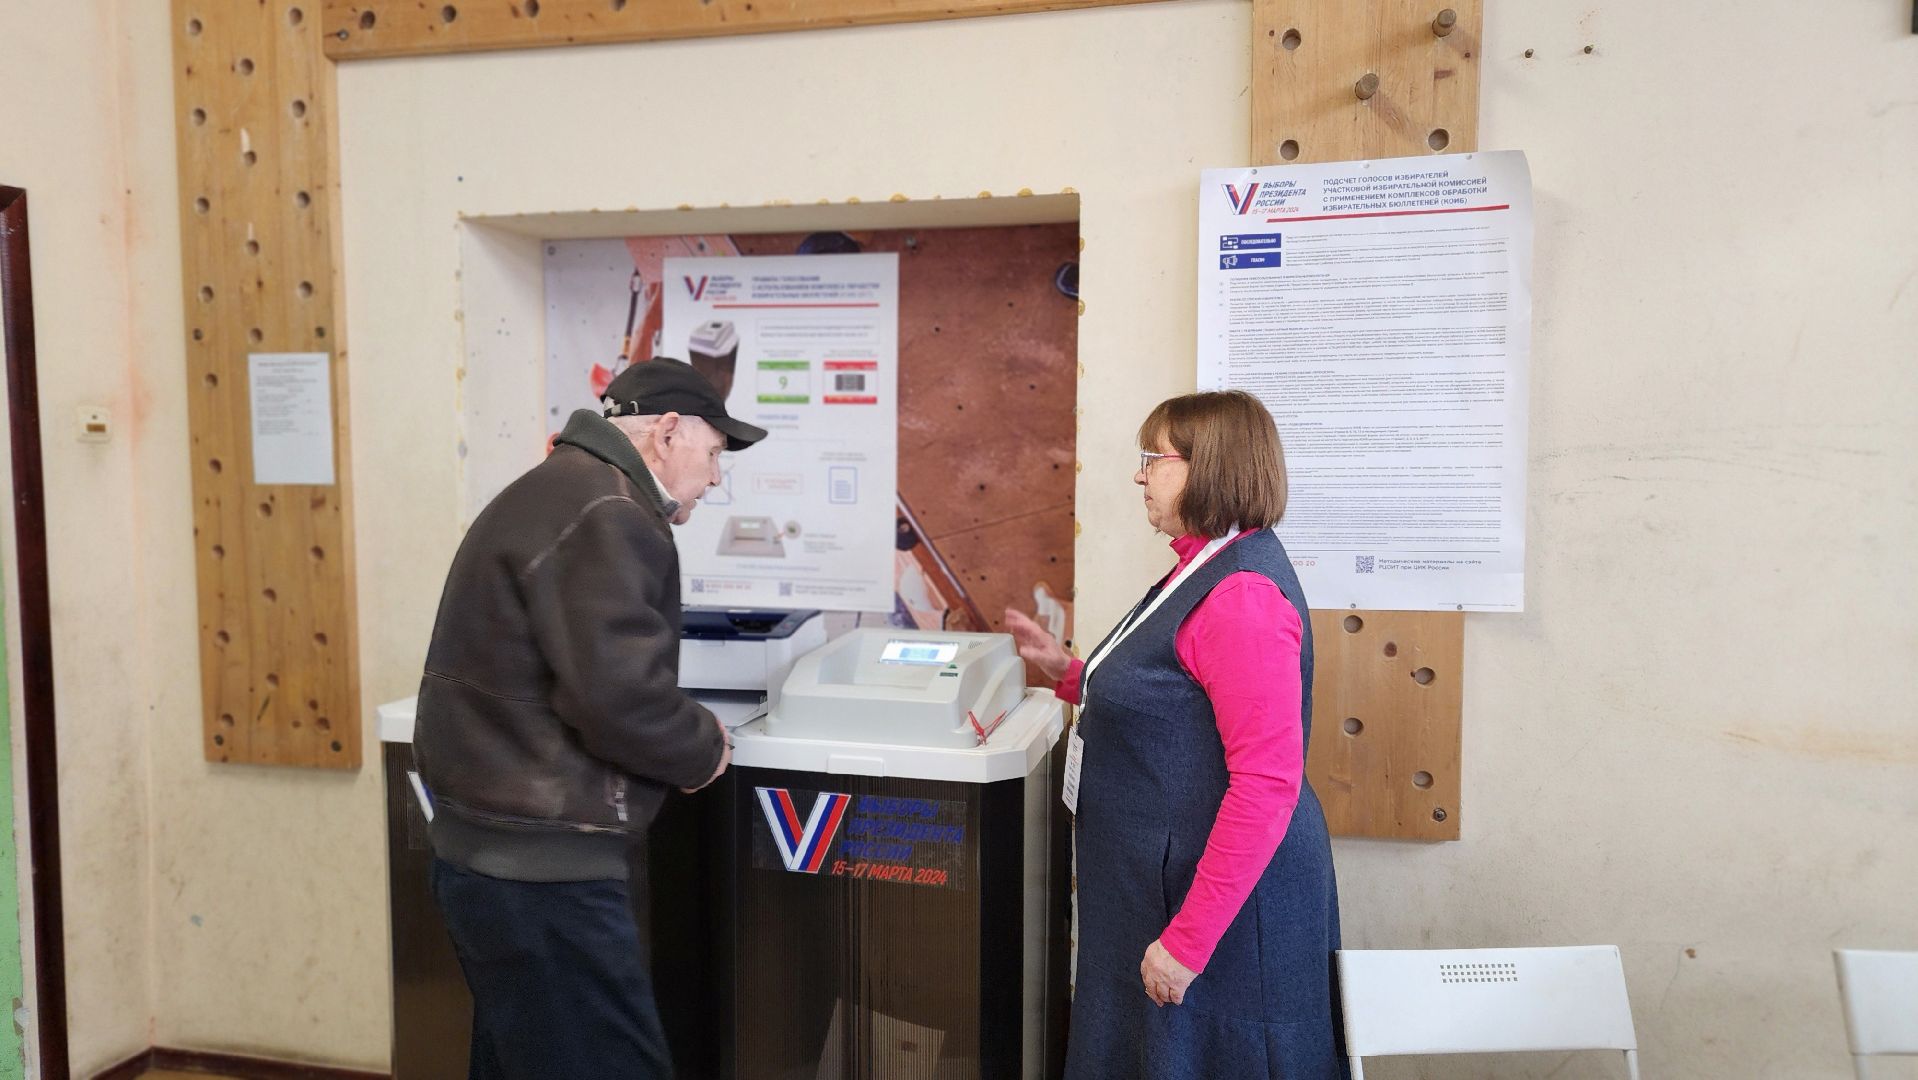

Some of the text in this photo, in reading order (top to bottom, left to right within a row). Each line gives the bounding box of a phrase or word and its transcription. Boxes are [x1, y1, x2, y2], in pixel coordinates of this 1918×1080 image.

[1263, 180, 1297, 189] ВЫБОРЫ
[1323, 170, 1449, 186] ПОДСЧЕТ ГОЛОСОВ ИЗБИРАТЕЛЕЙ
[1323, 176, 1487, 194] УЧАСТКОВОЙ ИЗБИРАТЕЛЬНОЙ КОМИССИЕЙ
[1259, 188, 1307, 198] ПРЕЗИДЕНТА
[1329, 193, 1386, 203] ПРИМЕНЕНИЕМ
[1388, 190, 1440, 199] КОМПЛЕКСОВ
[1442, 186, 1487, 196] ОБРАБОТКИ
[1255, 199, 1286, 207] РОССИИ
[1323, 197, 1468, 212] ИЗБИРАТЕЛЬНЫХ БЮЛЛЕТЕНЕЙ (КОИБ)
[857, 795, 940, 818] ВЫБОРЫ
[847, 817, 966, 844] ПРЕЗИДЕНТА
[840, 840, 913, 861] РОССИИ
[867, 863, 913, 881] МАРТА
[914, 868, 948, 885] 2024
